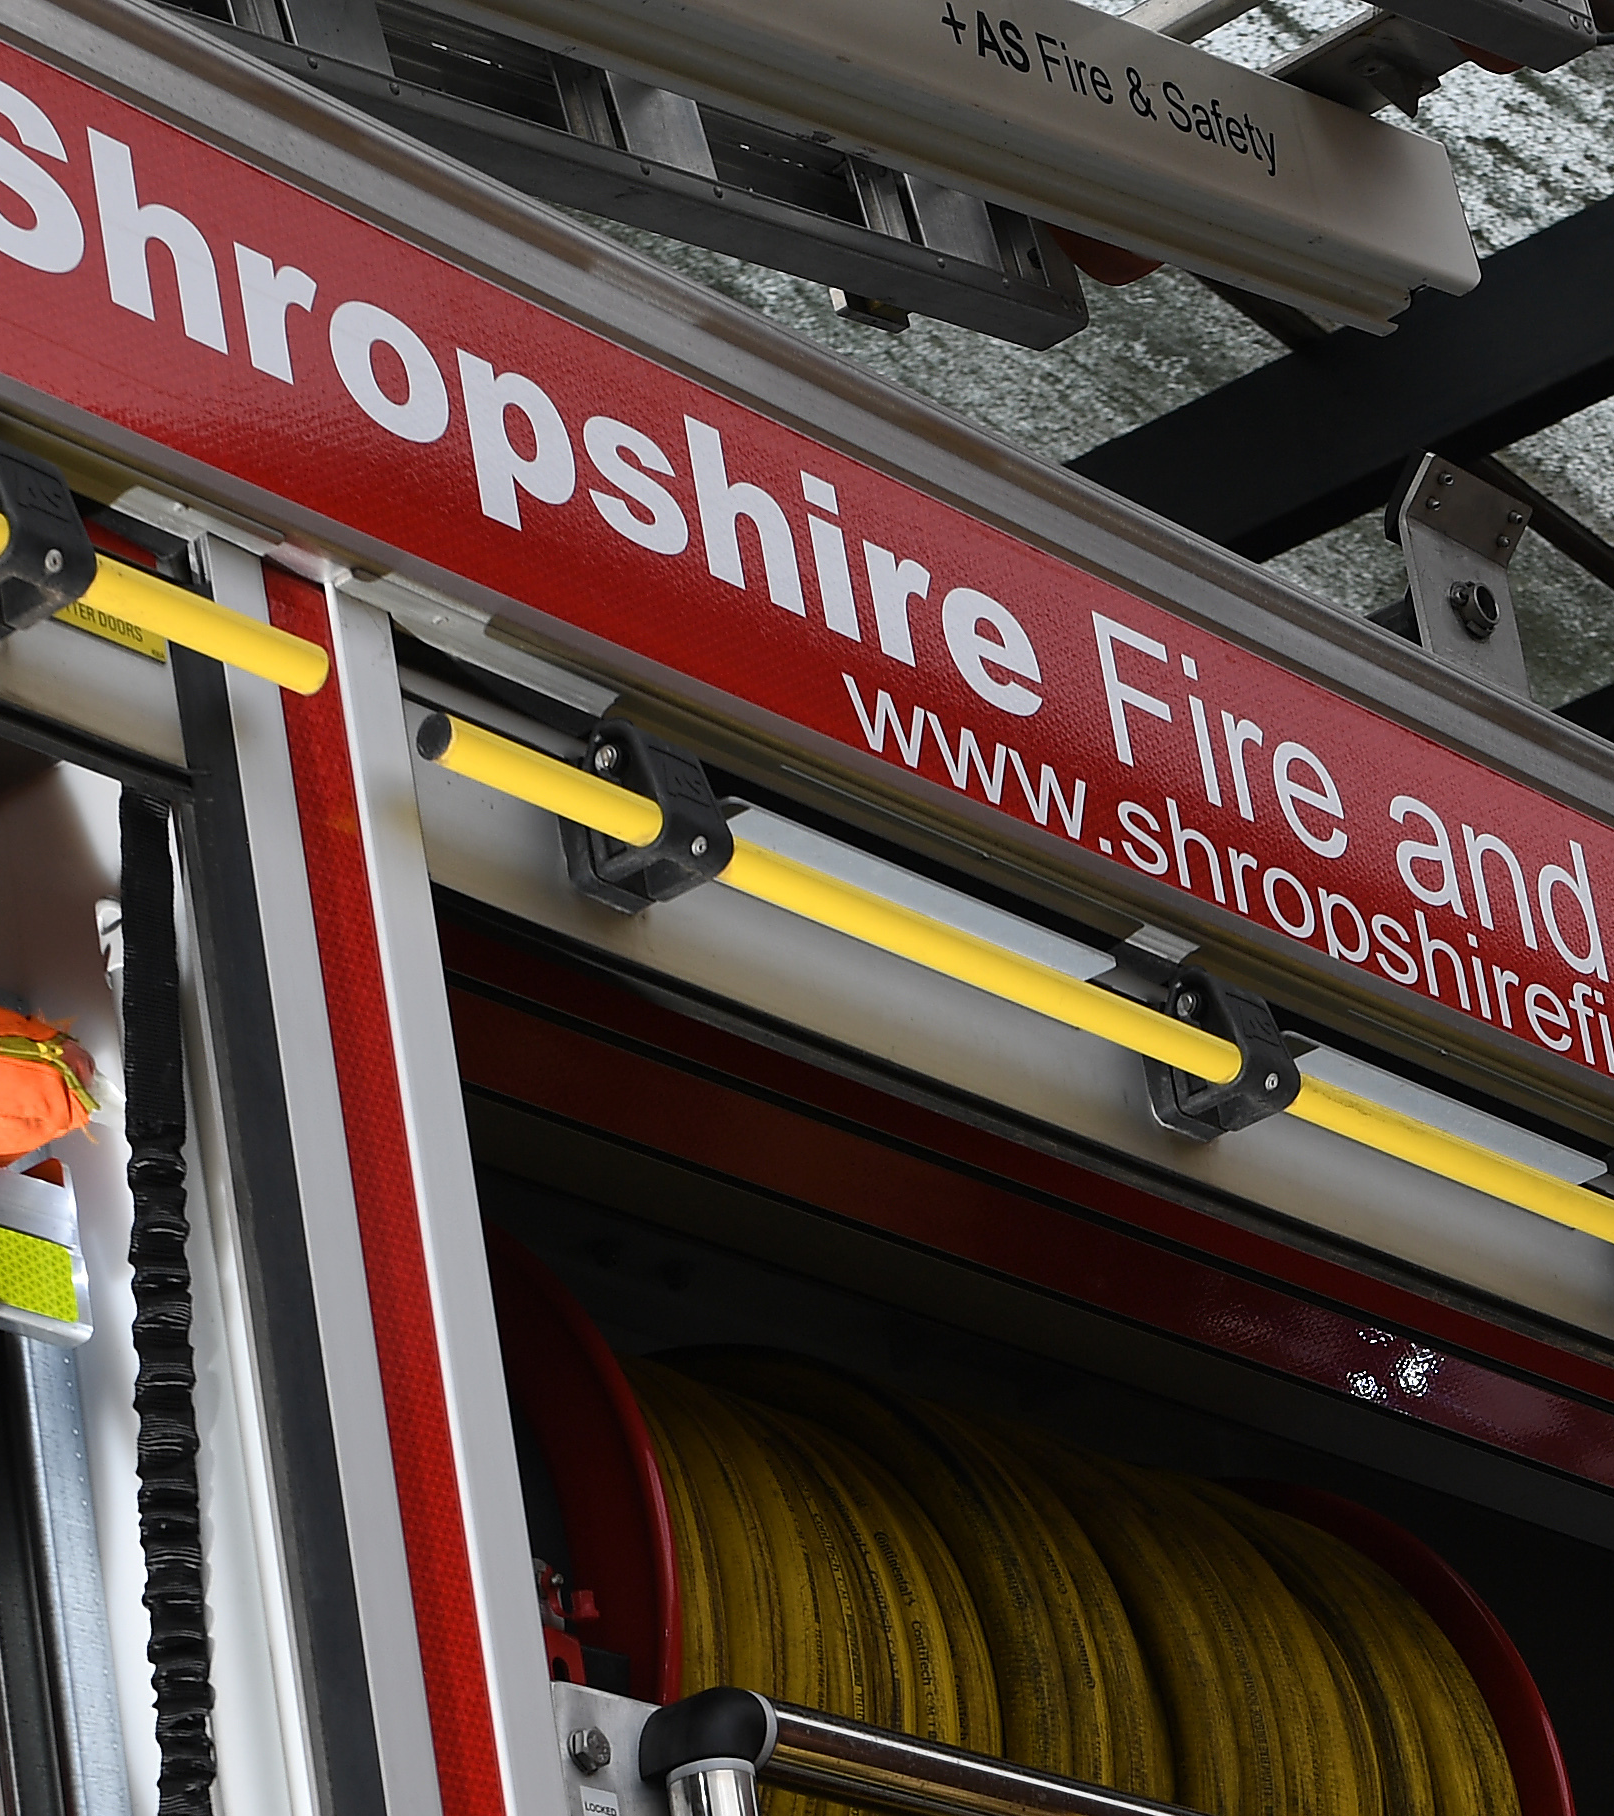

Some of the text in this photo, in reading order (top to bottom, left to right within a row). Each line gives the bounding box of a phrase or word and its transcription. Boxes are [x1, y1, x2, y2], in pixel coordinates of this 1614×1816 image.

[1035, 31, 1114, 105] Fire
[1125, 65, 1158, 122] &
[1162, 80, 1278, 178] Safety
[98, 610, 143, 642] DOORS
[1091, 610, 1348, 860] Fire
[1389, 795, 1608, 985] and
[874, 1530, 933, 1686] Continental ContiTech
[584, 1801, 617, 1816] LOCKED
